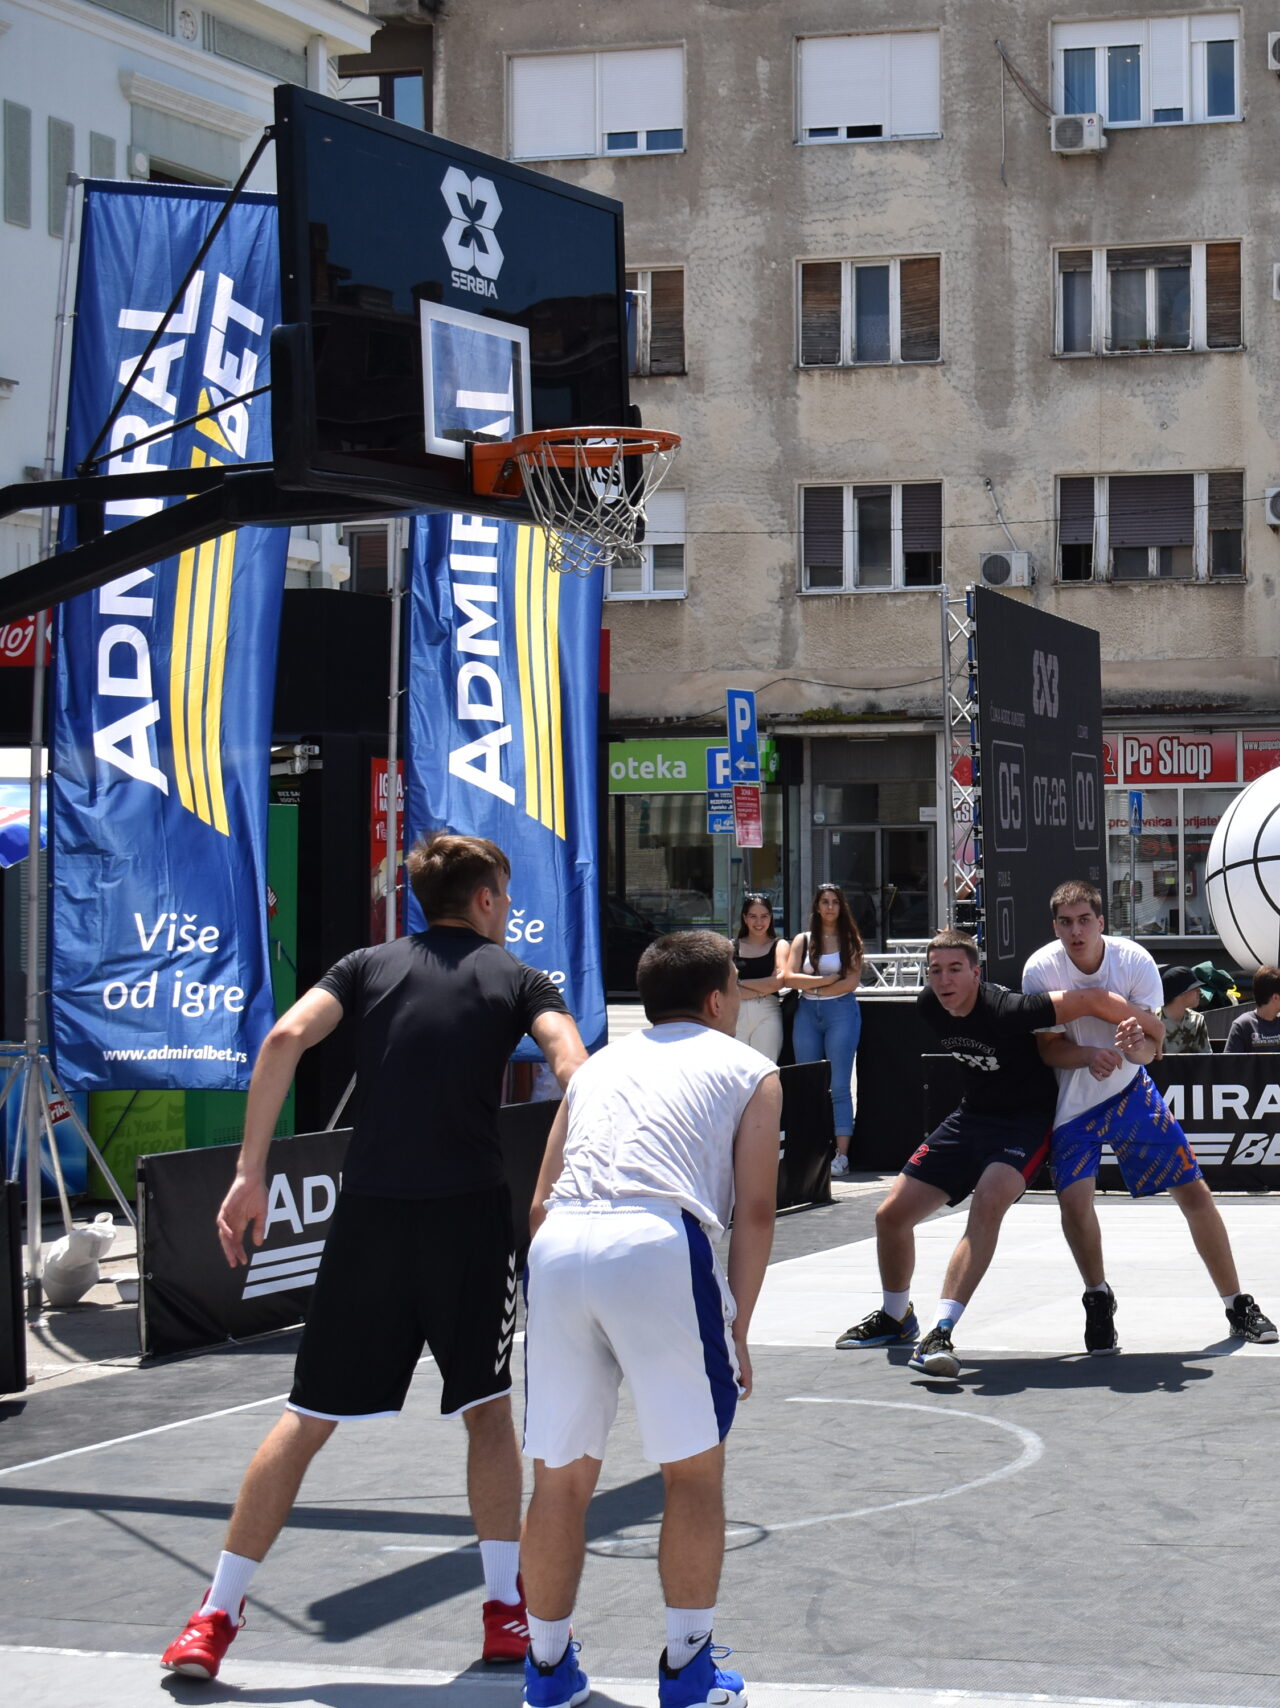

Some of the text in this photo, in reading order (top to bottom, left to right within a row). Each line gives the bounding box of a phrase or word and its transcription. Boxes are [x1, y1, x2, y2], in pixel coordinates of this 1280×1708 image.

[451, 270, 499, 300] SERBIA
[735, 697, 751, 743] P
[610, 754, 687, 780] oteka
[1125, 736, 1212, 780] Pc Shop
[999, 761, 1095, 831] 05 07:26 00
[1108, 816, 1172, 830] provnica
[134, 912, 220, 954] Više
[504, 908, 545, 944] še
[1002, 906, 1010, 947] 0
[103, 969, 245, 1018] od igre
[103, 1044, 248, 1063] www.admiralbet.rs
